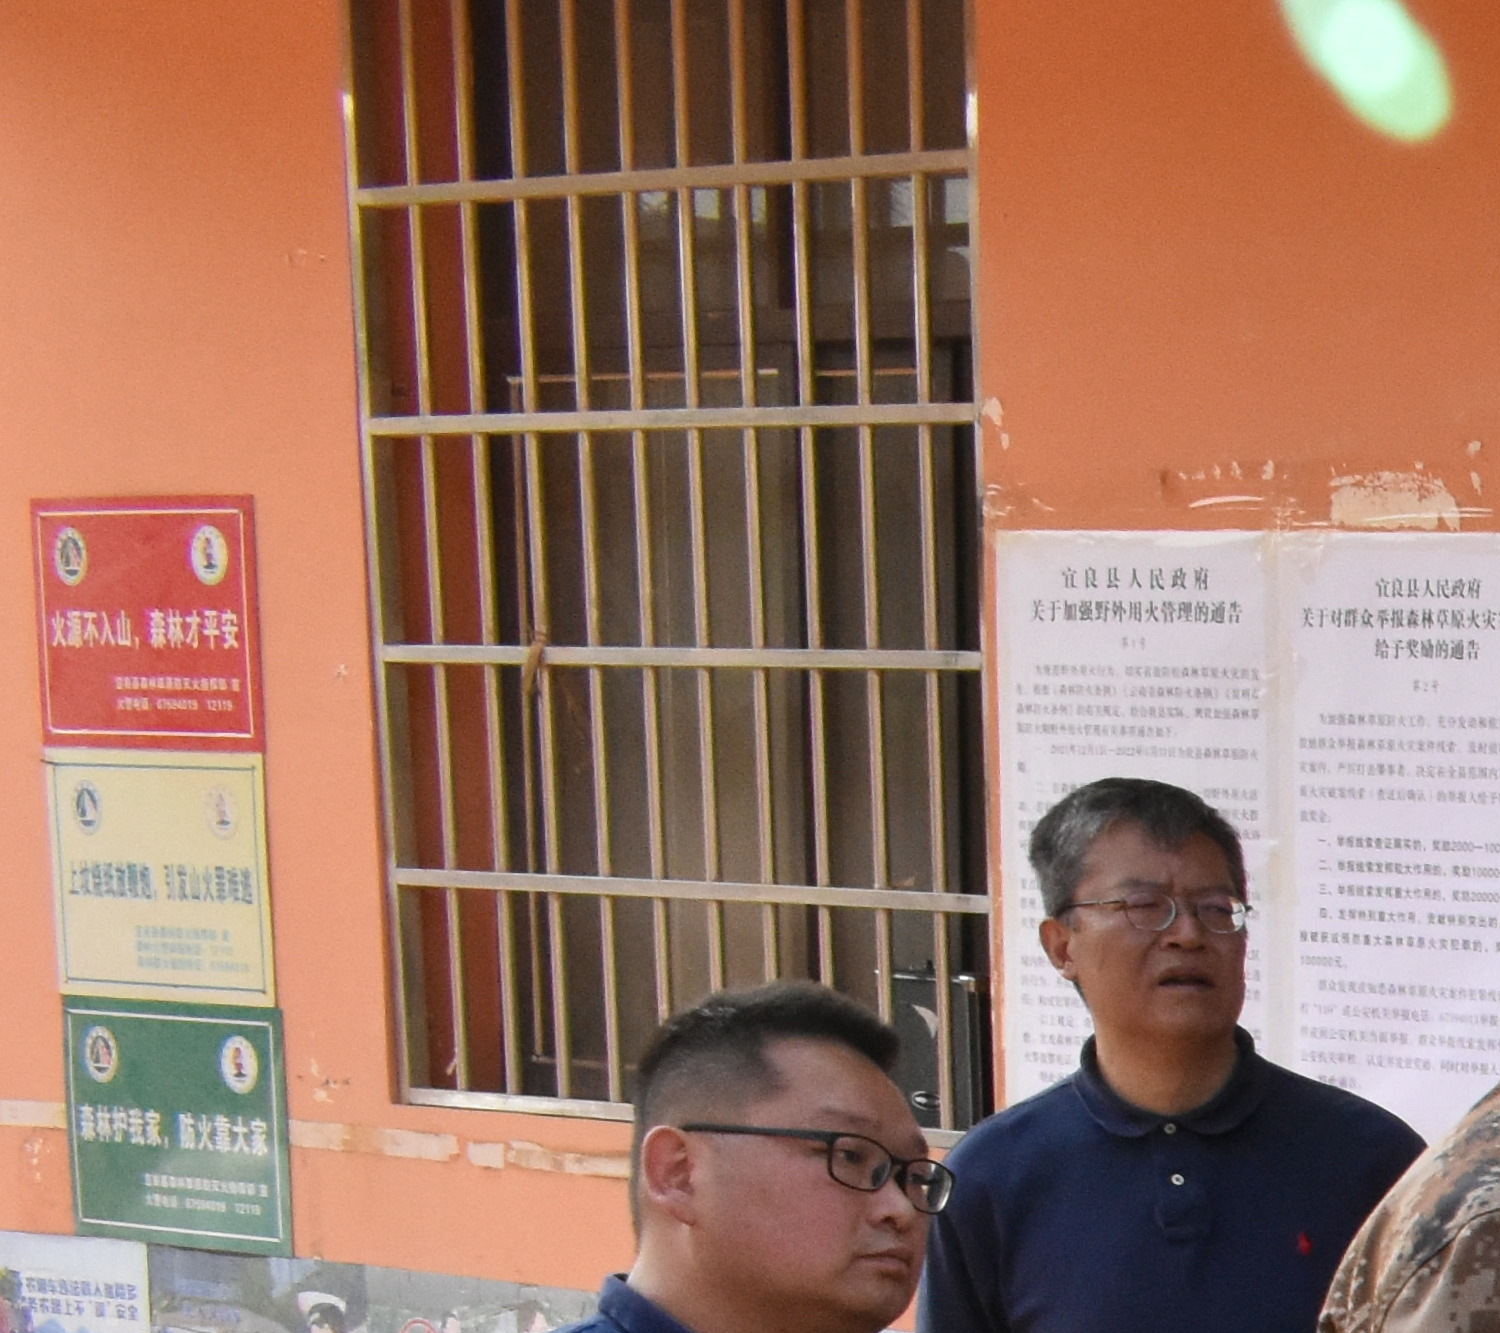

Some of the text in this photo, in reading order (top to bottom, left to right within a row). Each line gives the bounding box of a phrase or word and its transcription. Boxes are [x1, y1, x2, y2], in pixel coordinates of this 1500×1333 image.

[1061, 567, 1209, 591] 宜良县人民政府
[1375, 577, 1482, 599] 宜良县人民政府
[1031, 600, 1243, 624] 关于加强野外用火管理的通告
[1375, 638, 1480, 660] 给予奖励的通告
